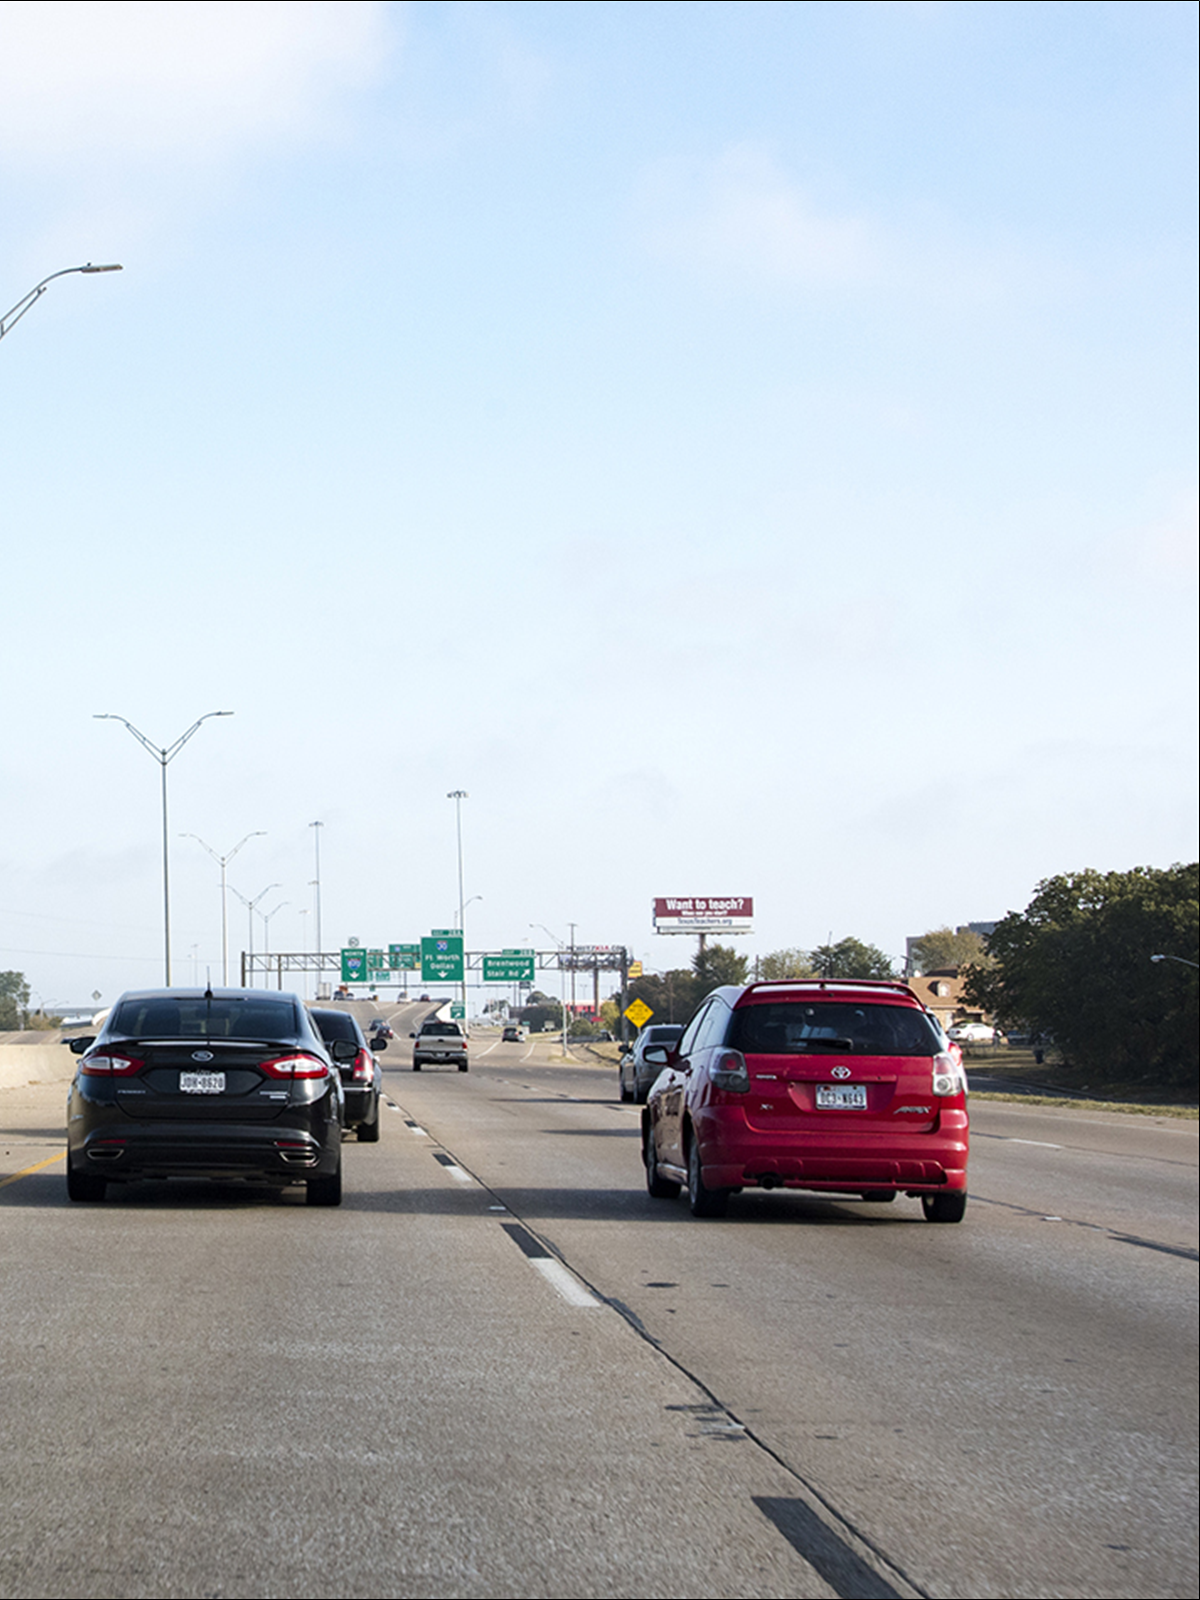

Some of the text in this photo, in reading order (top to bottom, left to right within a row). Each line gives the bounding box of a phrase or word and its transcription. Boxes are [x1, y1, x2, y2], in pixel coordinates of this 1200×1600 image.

[666, 899, 744, 910] Want to teach?
